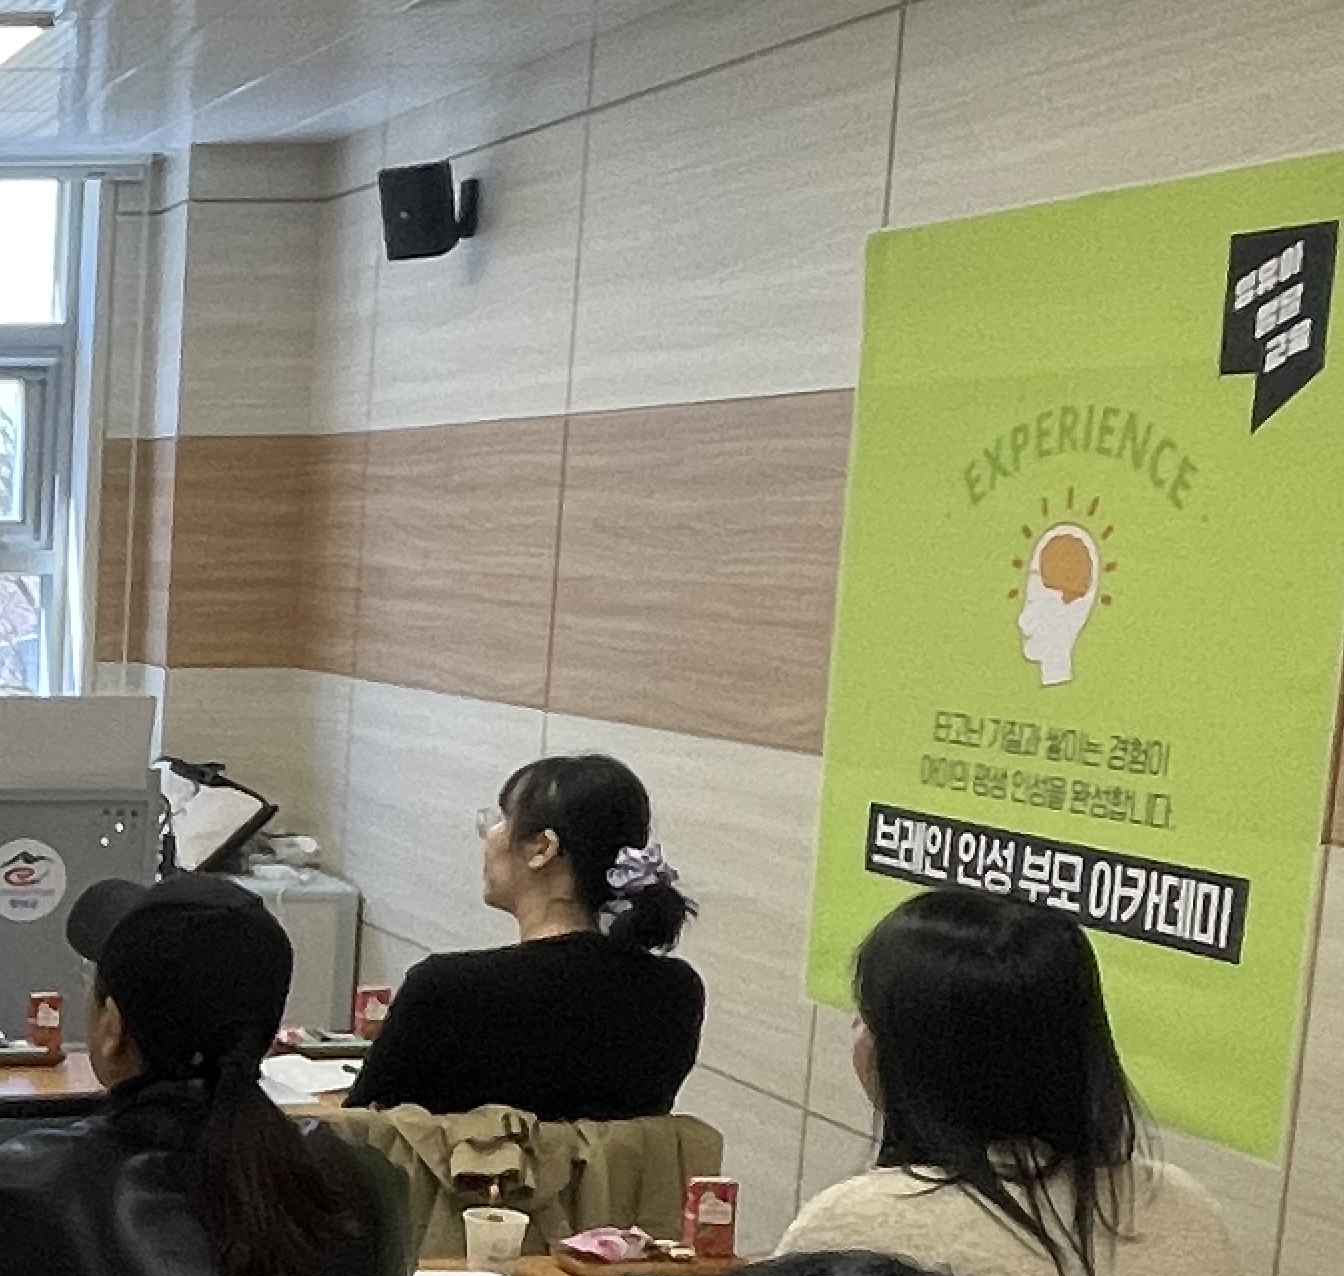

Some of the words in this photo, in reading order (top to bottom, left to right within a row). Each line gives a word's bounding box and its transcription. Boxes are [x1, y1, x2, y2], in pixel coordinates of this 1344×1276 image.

[963, 403, 1201, 511] EXPERIENCE
[920, 752, 970, 791] 아이의
[972, 762, 1009, 800] 평생
[1011, 768, 1068, 811] 인성을
[934, 710, 984, 749] 타고난
[988, 716, 1042, 757] 기질과
[1107, 734, 1171, 777] 경험이
[871, 812, 953, 881] 브레인
[955, 830, 1017, 896] 인성
[1018, 845, 1085, 914] 부모
[1087, 860, 1236, 950] 아카데미
